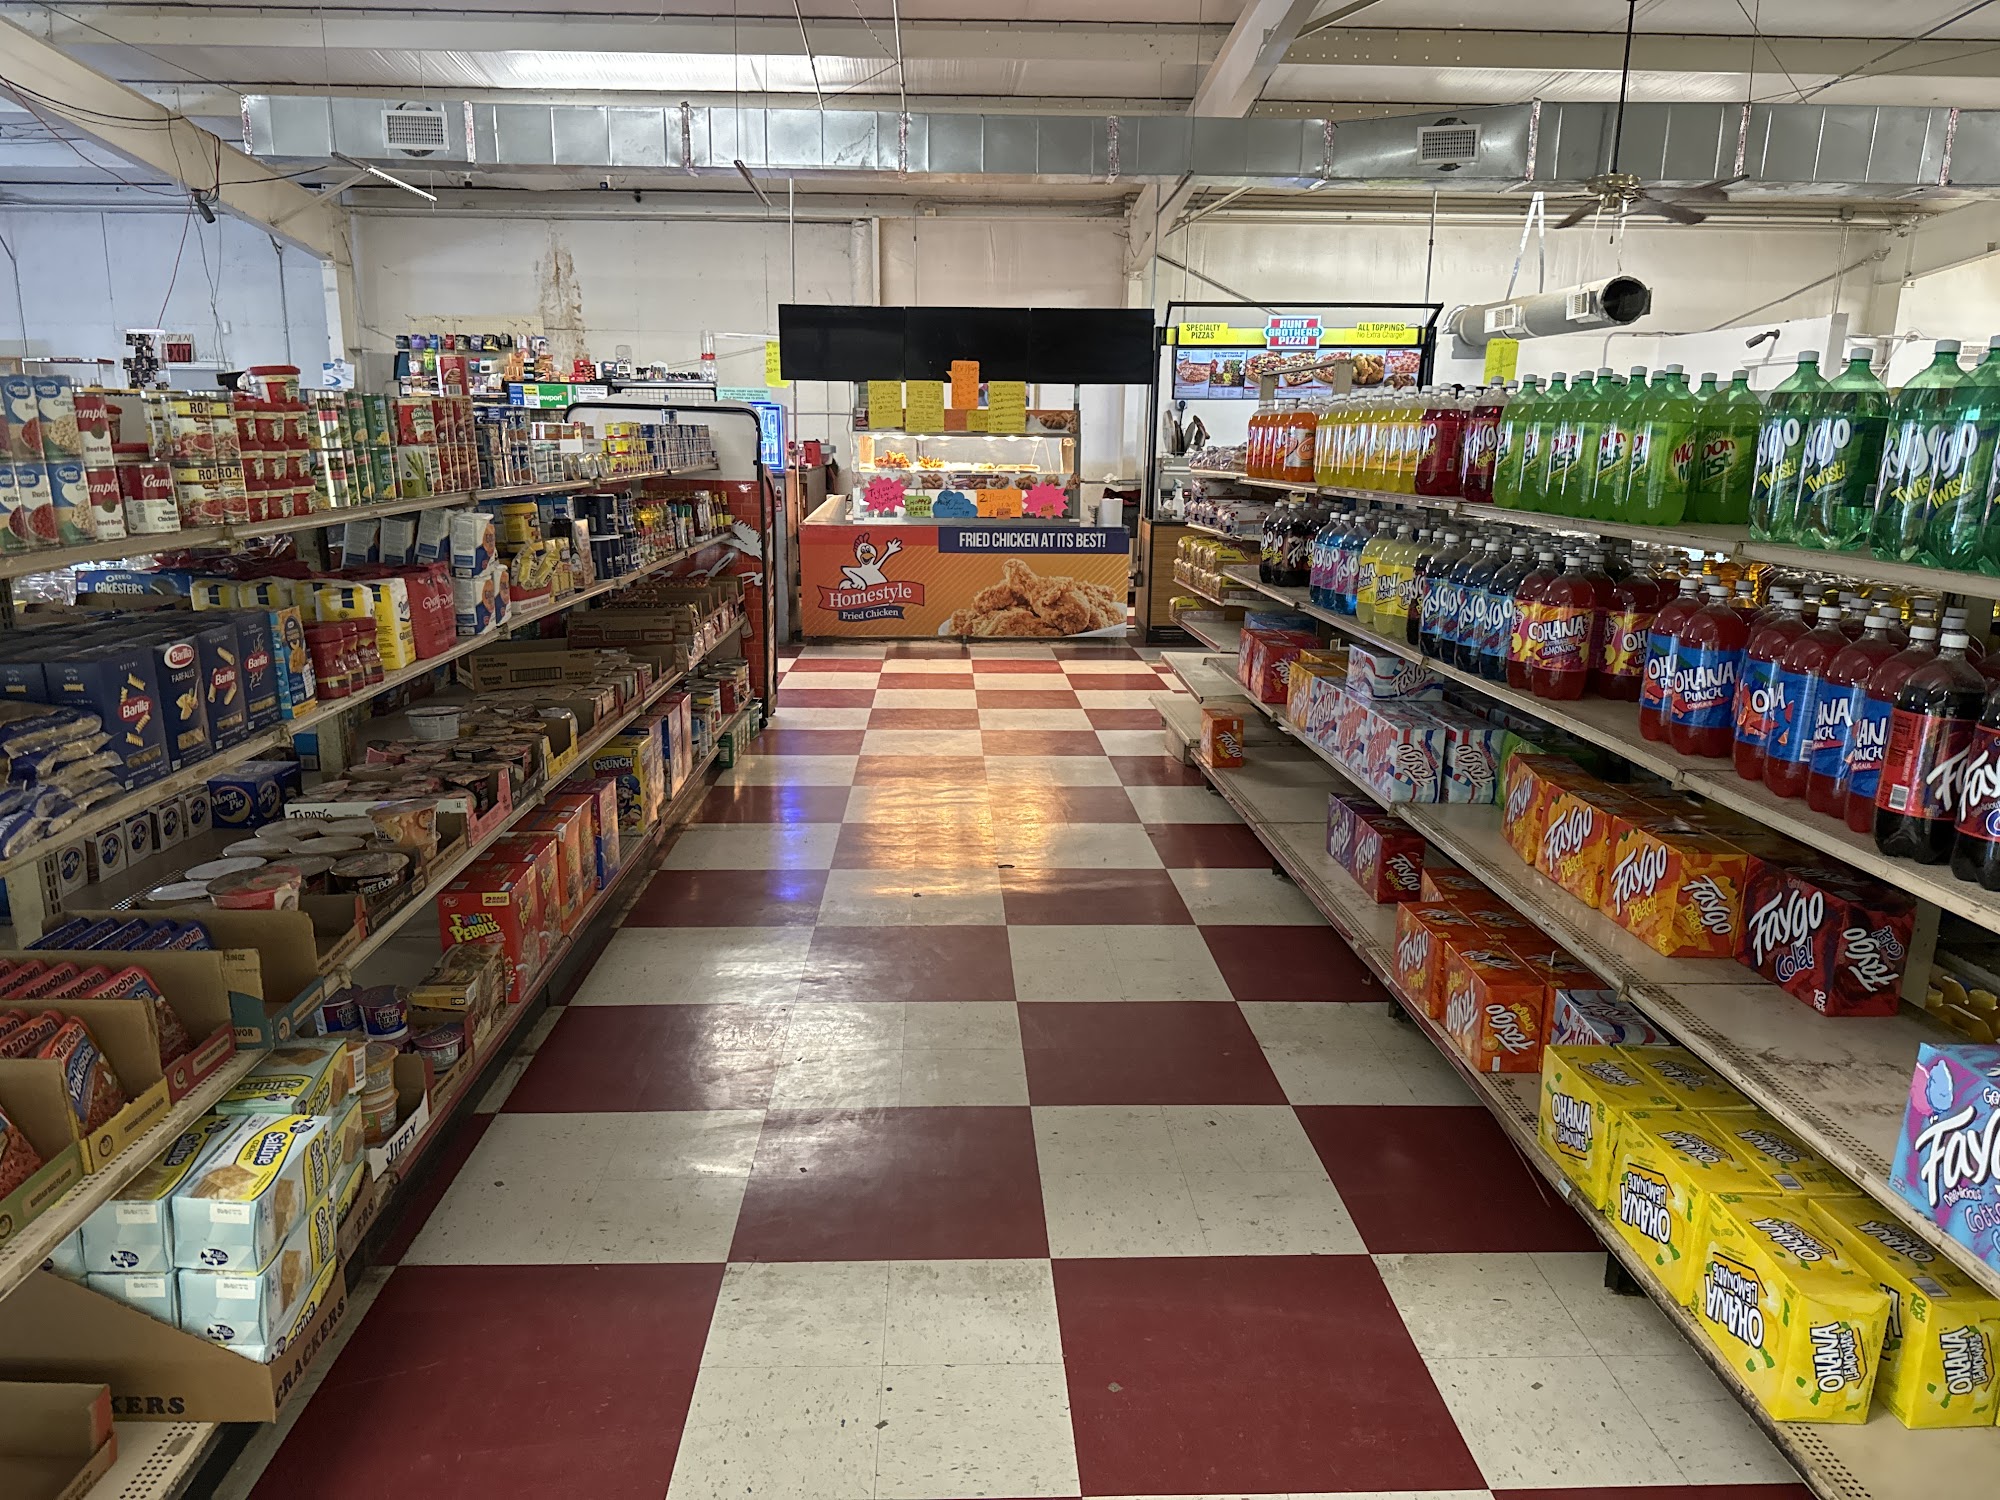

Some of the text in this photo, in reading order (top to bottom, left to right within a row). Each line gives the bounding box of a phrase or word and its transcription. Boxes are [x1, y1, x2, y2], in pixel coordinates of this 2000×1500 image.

[1186, 324, 1220, 332] SPECIALTY
[1191, 332, 1214, 340] PIZZAS
[1268, 328, 1320, 337] BROTHERS
[1279, 319, 1309, 328] HUNT
[1358, 323, 1405, 332] ALL TOPPINGS
[1383, 332, 1405, 340] Charge!
[1278, 336, 1309, 345] PIZZA
[1758, 458, 1797, 490] Twist!
[1804, 460, 1847, 493] Twist!
[959, 532, 1106, 548] FRIED CHICKEN AT ITS BEST!
[95, 583, 144, 594] CAKESTERS
[106, 574, 132, 582] OREO
[829, 586, 912, 608] Homestyle
[842, 608, 899, 620] Fried Chicken
[171, 649, 192, 662] Barilla
[248, 656, 268, 669] Barilla
[171, 669, 196, 682] FARFALLE
[215, 670, 236, 685] Barilla
[1675, 660, 1735, 692] OHANA
[122, 702, 150, 720] Barilla
[1684, 687, 1724, 702] PUNCH
[1216, 731, 1242, 758] Faygo
[594, 756, 634, 771] CRUNCH
[1396, 743, 1438, 788] Faygo
[1456, 744, 1497, 789] Faygo
[212, 791, 238, 806] Moon
[229, 799, 244, 810] Pie
[1507, 773, 1533, 825] Faygo
[1355, 832, 1378, 878] Faygo
[1544, 805, 1594, 872] Faygo
[1386, 853, 1421, 892] Faygo
[1560, 852, 1584, 881] Peach!
[1610, 844, 1668, 916] Faygo
[450, 912, 493, 926] FRUITY
[1628, 893, 1658, 926] Peach!
[1682, 874, 1732, 936] Faygo
[449, 920, 500, 943] PEBBLES
[1749, 889, 1824, 967] Faygo
[1872, 925, 1905, 960] Cola!
[1398, 930, 1428, 980] Faygo
[1775, 936, 1816, 982] Cola!
[1842, 926, 1900, 993] Faygo
[375, 1008, 400, 1020] Raisin
[1446, 978, 1478, 1036] Faygo
[1, 1018, 54, 1058] Maruchan
[54, 1024, 85, 1059] Maruchan
[1485, 1003, 1536, 1055] Faygo
[70, 1044, 96, 1100] Yakisoba
[1552, 1092, 1593, 1140] OHANA
[164, 1134, 201, 1167] Saltine
[254, 1132, 288, 1166] Saltine
[386, 1121, 417, 1165] JIFFY
[1556, 1124, 1587, 1152] LEMONADE
[1628, 1171, 1667, 1206] LEMONADE
[1620, 1183, 1672, 1245] OHANA
[1750, 1218, 1822, 1262] OHANA
[1712, 1261, 1759, 1300] LEMONADE
[1704, 1274, 1764, 1349] OHANA
[275, 1298, 346, 1410] CRACKERS
[1810, 1321, 1846, 1394] OHANA
[1837, 1327, 1861, 1383] LEMONADE
[1939, 1326, 1975, 1395] OHANA
[1966, 1331, 1989, 1387] LEMONADE
